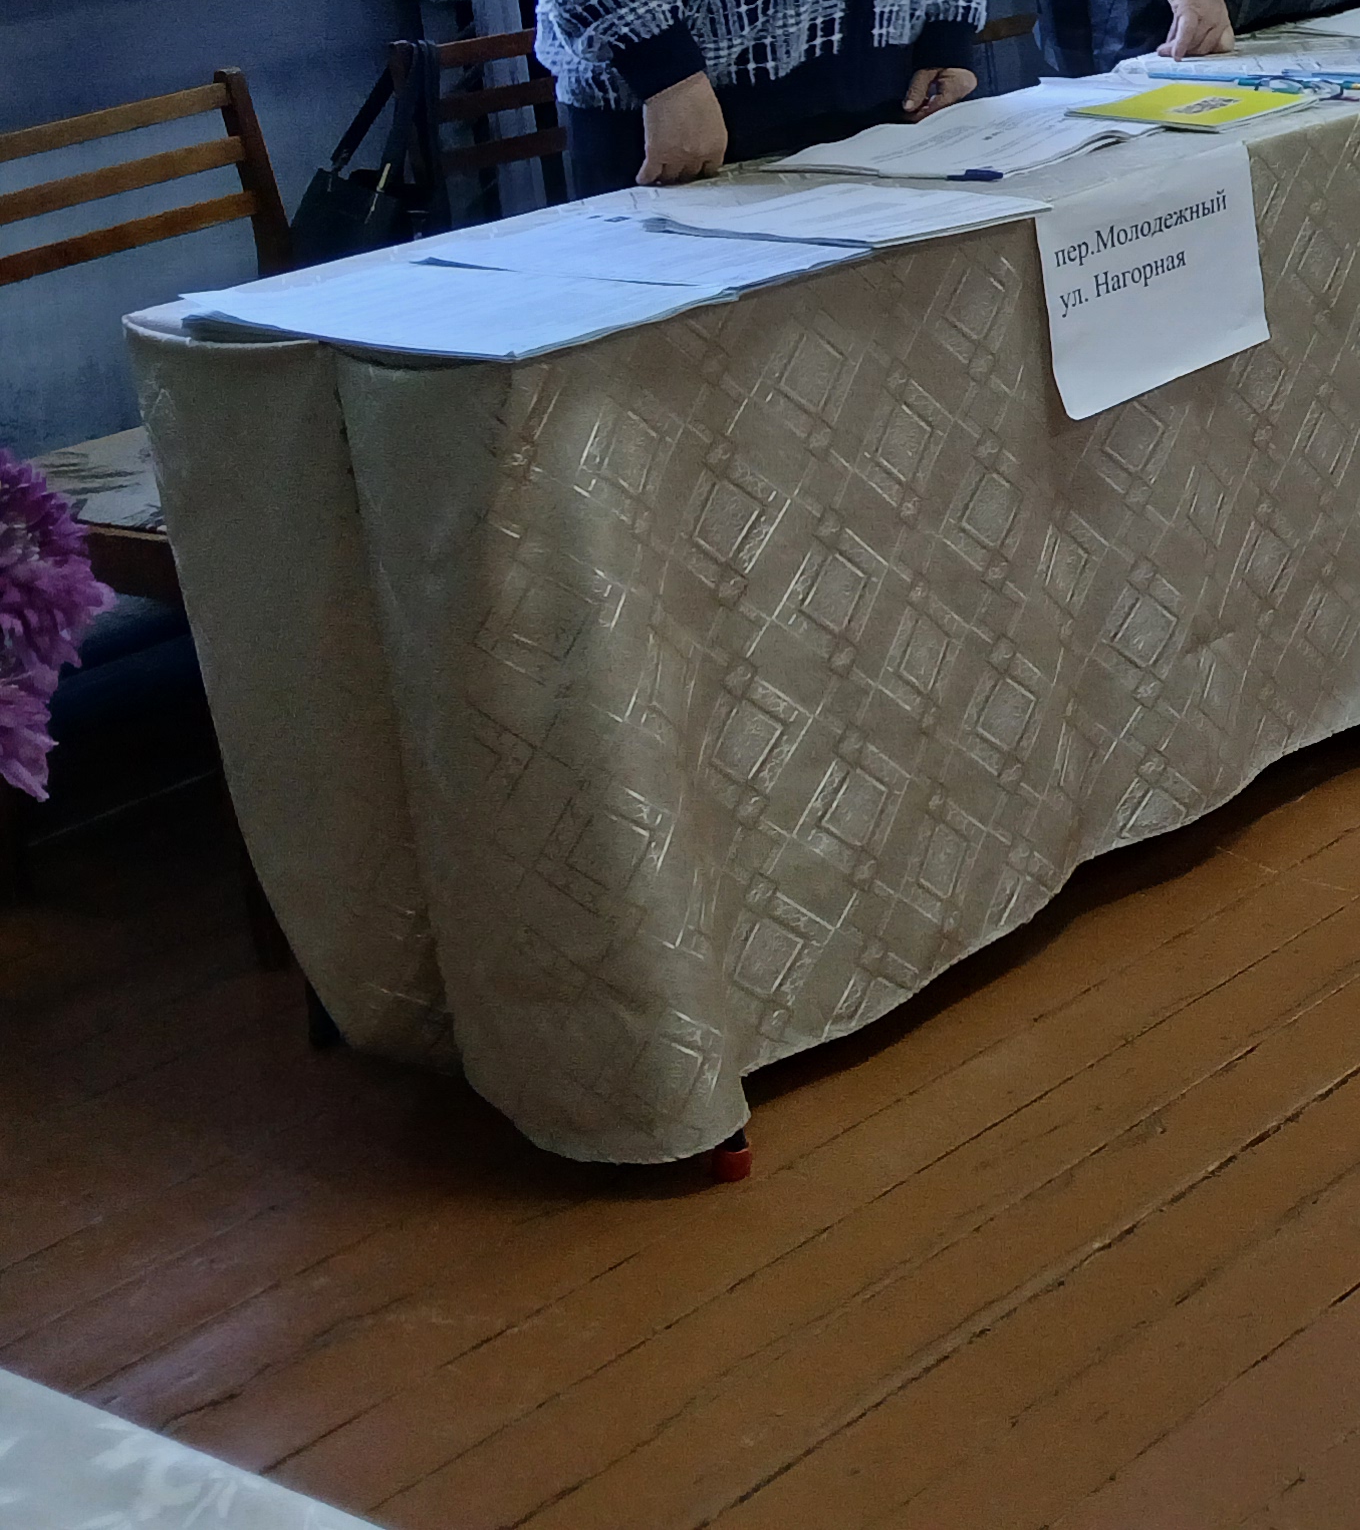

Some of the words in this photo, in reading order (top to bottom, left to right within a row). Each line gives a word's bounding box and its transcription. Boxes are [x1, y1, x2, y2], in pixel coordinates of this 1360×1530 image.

[1054, 189, 1228, 268] пер.Молодежный
[1059, 289, 1089, 318] ул.
[1093, 250, 1187, 298] Нагорная
